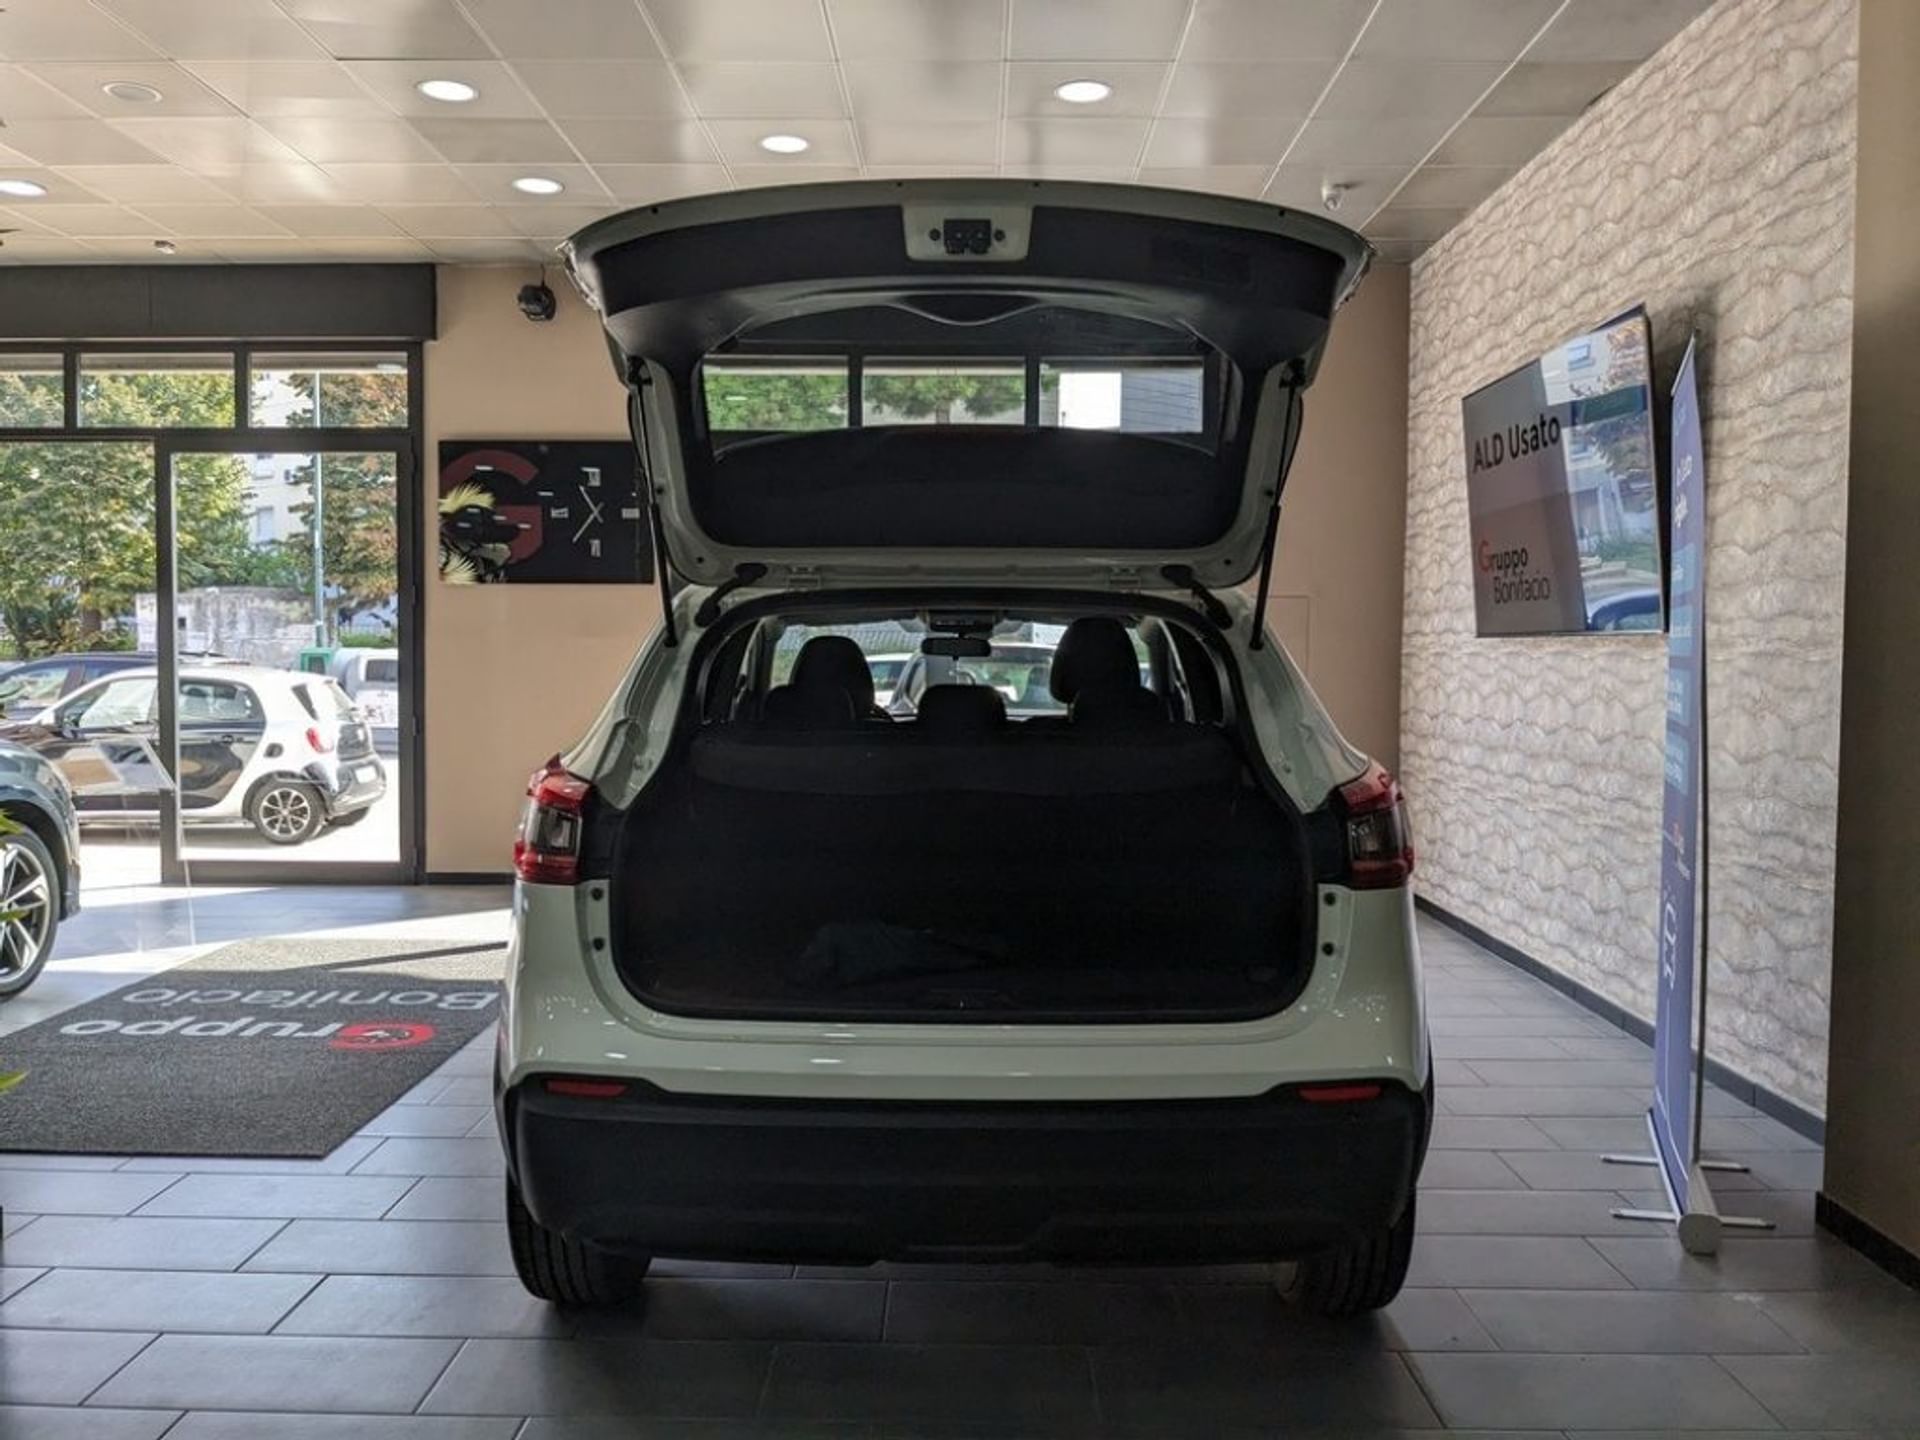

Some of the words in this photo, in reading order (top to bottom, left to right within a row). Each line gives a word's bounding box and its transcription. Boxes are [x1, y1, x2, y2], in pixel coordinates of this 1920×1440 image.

[1472, 431, 1504, 475] ALD
[1508, 412, 1561, 460] Usato
[1479, 540, 1529, 578] Gruppo
[1493, 569, 1551, 604] Bonifacio
[122, 987, 498, 1011] Bonifacio
[59, 1015, 437, 1050] Gruppo
